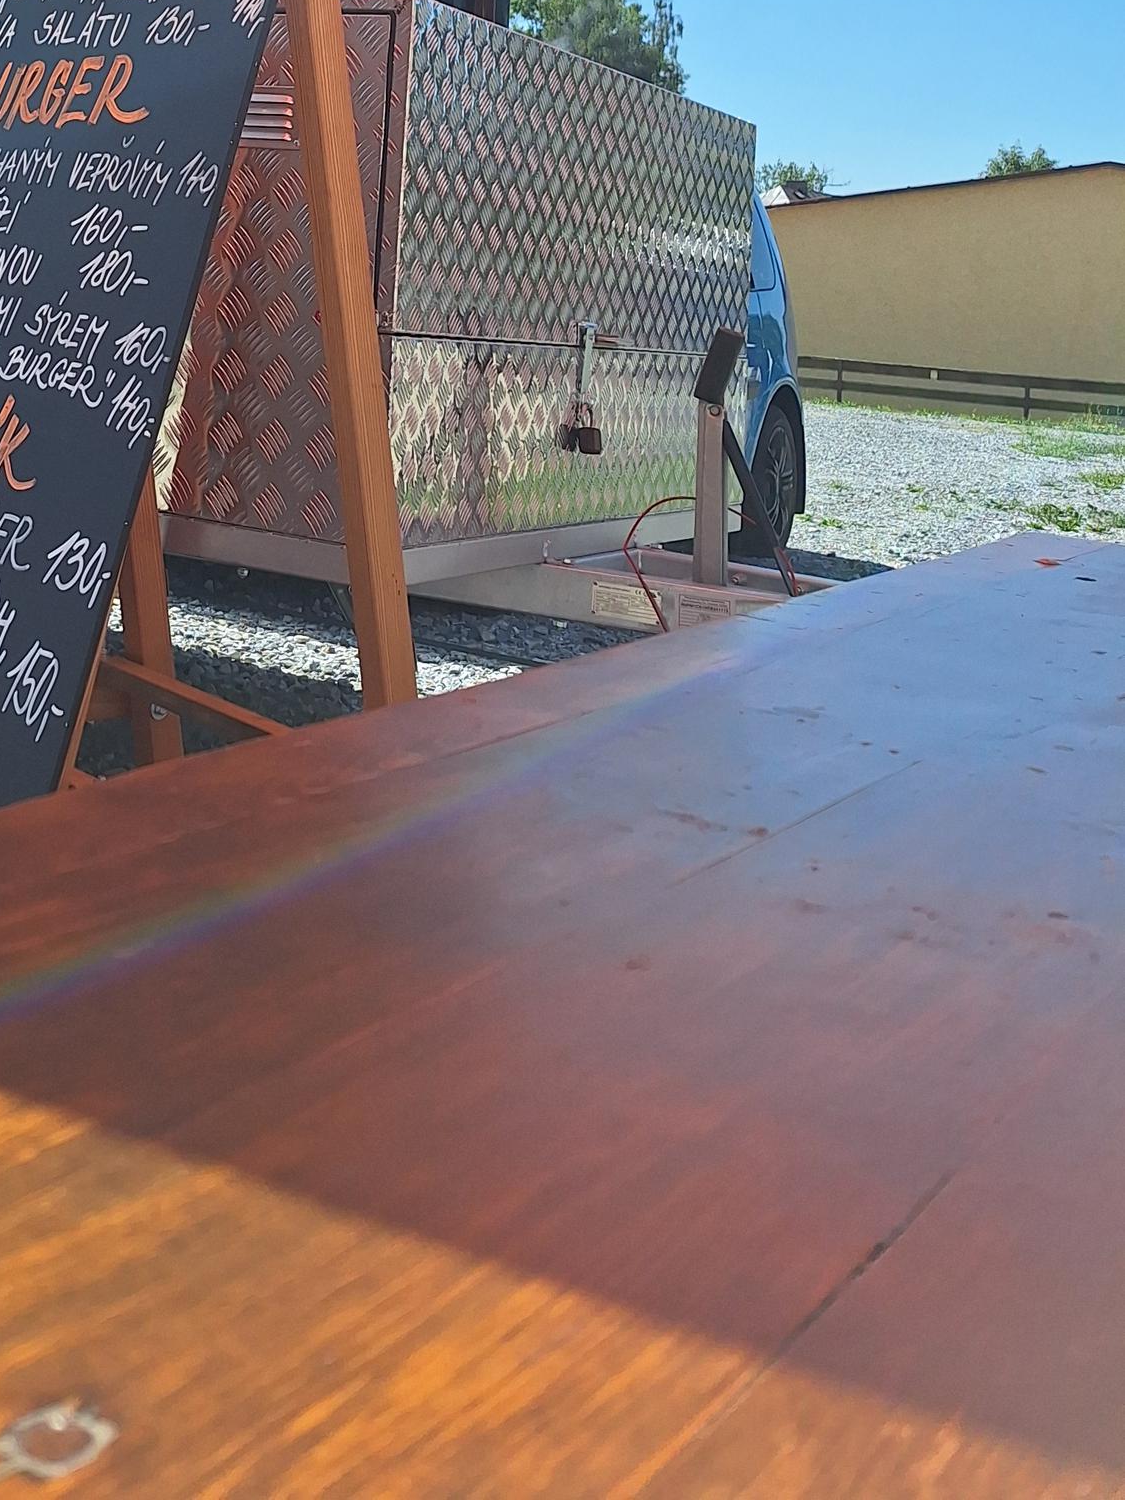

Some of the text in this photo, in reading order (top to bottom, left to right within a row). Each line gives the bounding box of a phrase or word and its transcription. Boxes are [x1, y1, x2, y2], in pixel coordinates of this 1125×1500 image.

[33, 1, 132, 49] SALÁTU
[145, 5, 211, 47] 130,-
[70, 203, 149, 249] 160,-
[79, 248, 149, 297] 180,-
[23, 290, 110, 365] SÝREM
[114, 322, 172, 375] 160,-
[1, 640, 65, 743] 150,-
